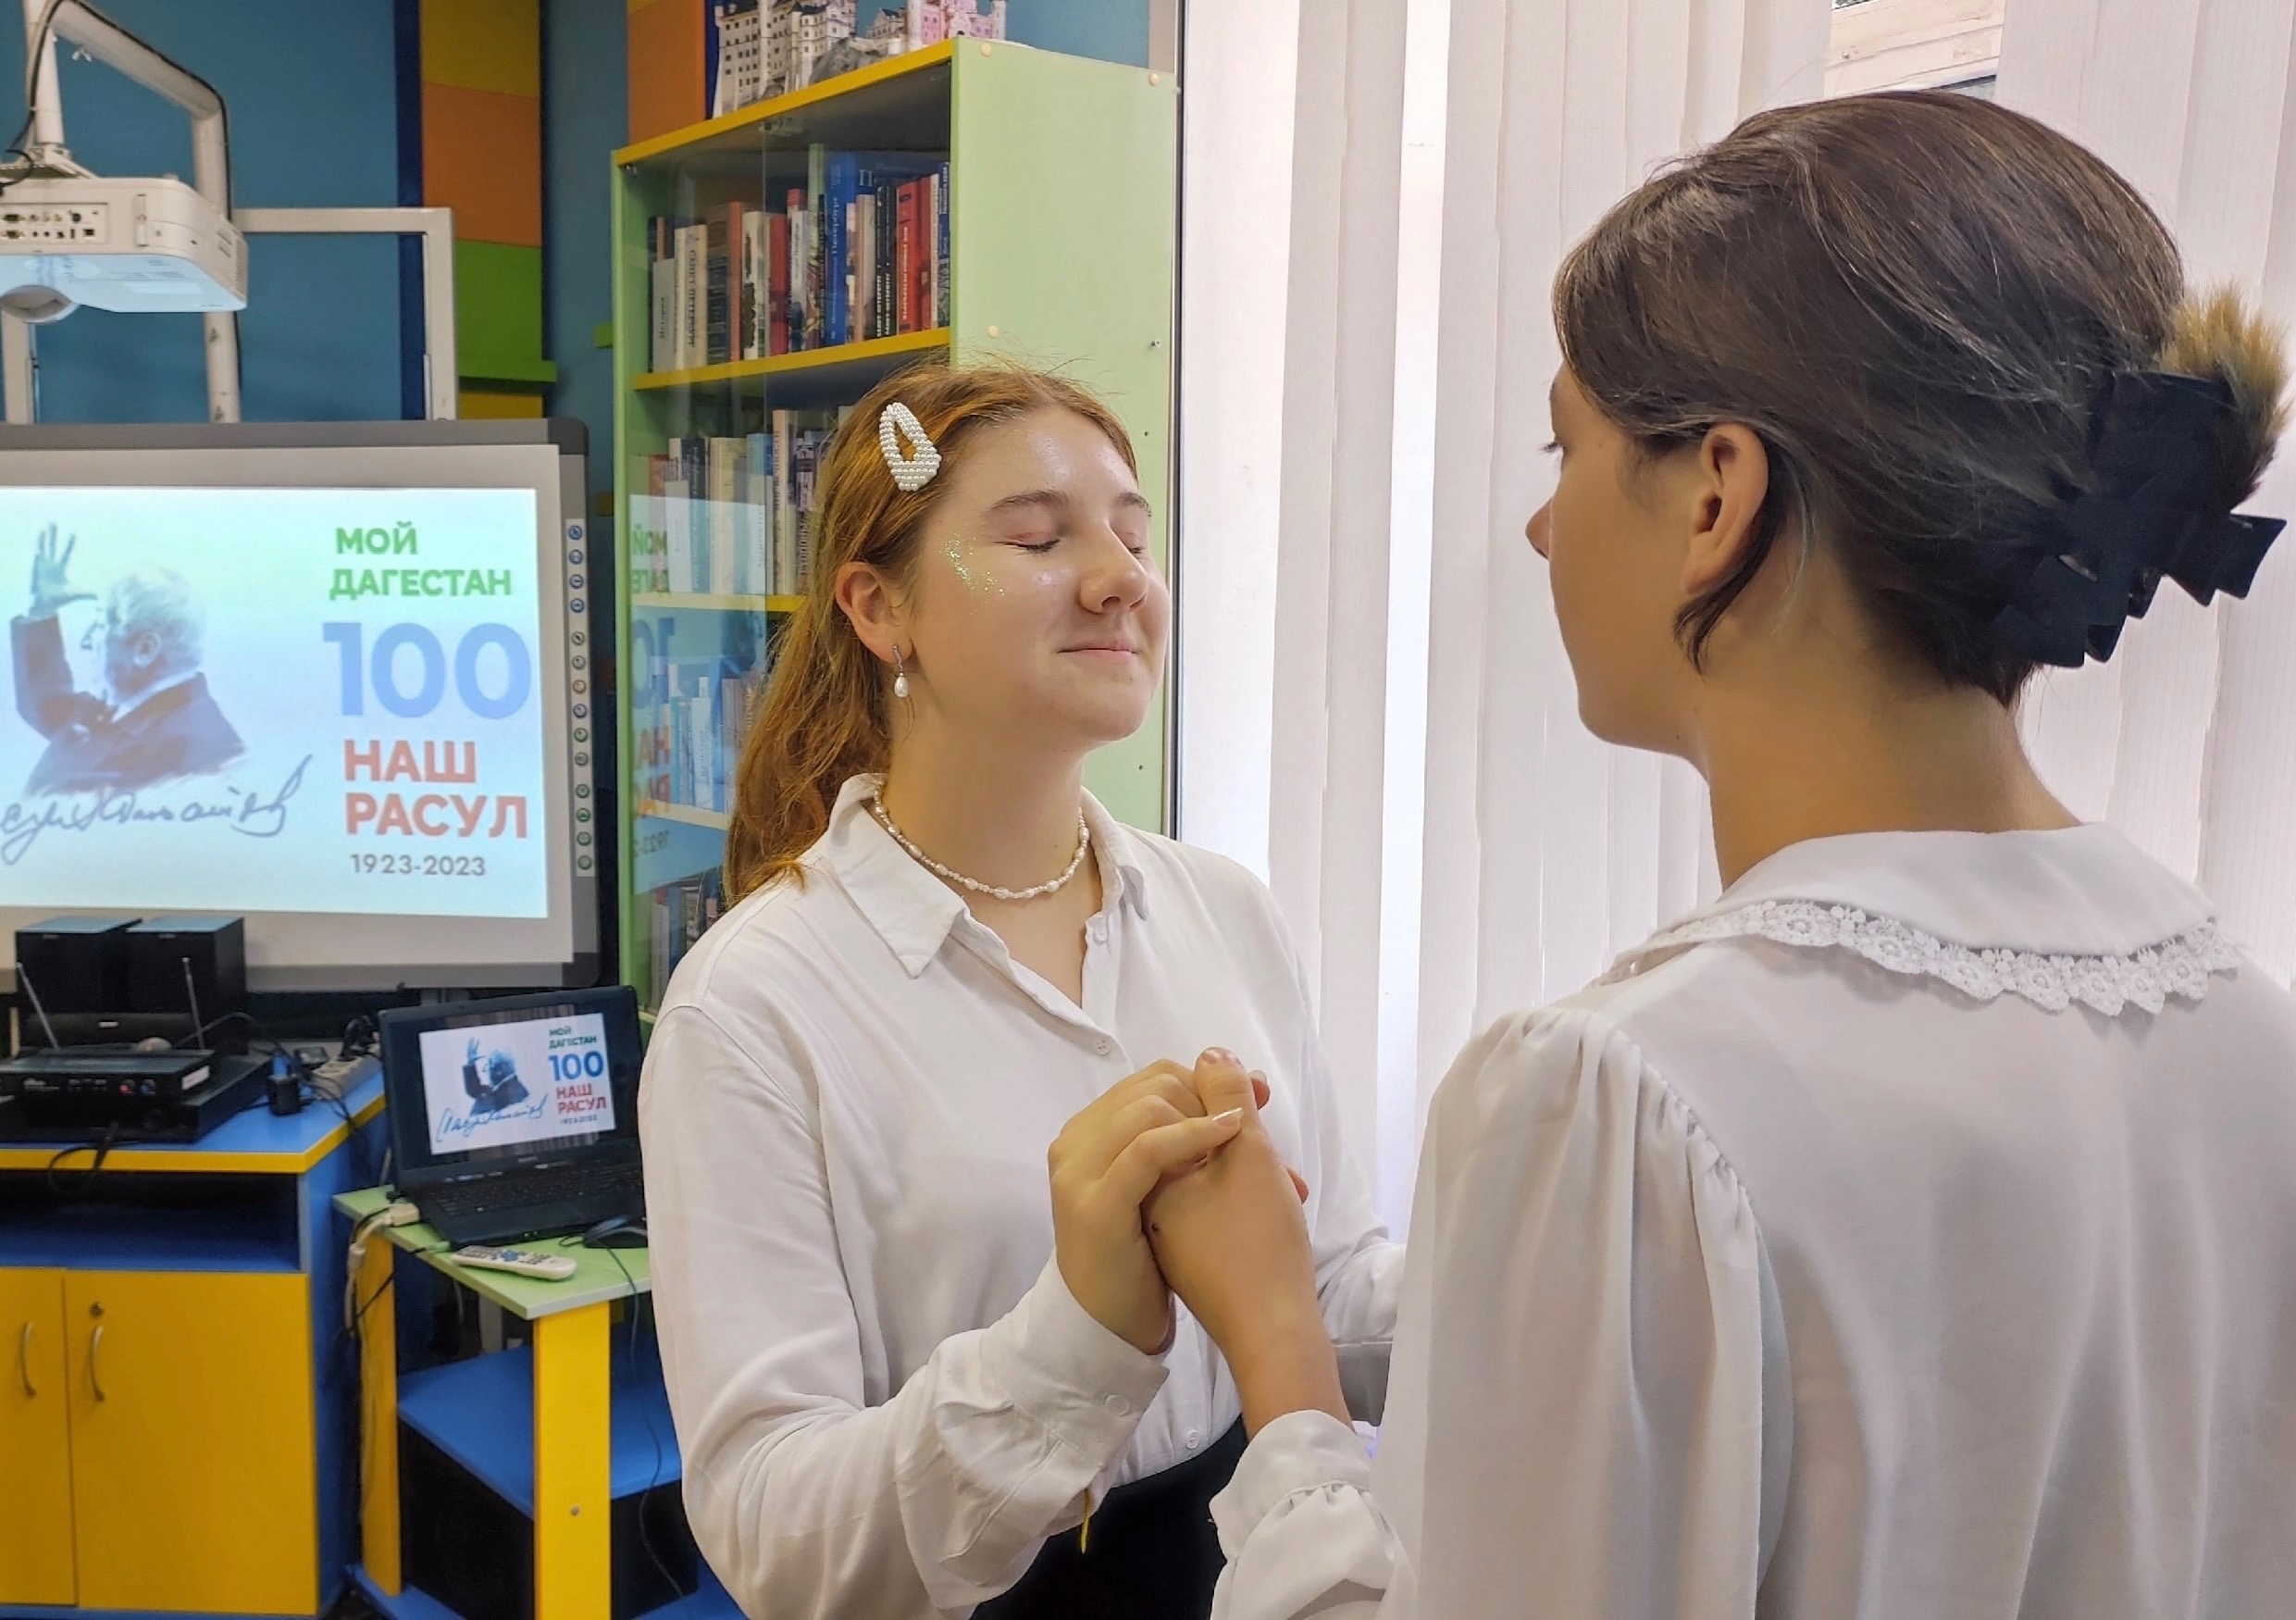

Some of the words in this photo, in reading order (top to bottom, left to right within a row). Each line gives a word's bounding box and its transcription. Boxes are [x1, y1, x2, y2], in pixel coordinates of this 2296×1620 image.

[336, 520, 417, 555] МОЙ
[329, 567, 512, 601] ДАГЕСТАН
[322, 621, 531, 720] 100
[344, 739, 477, 784] НАШ
[345, 791, 528, 839] РАСУЛ
[350, 853, 487, 877] 1923-2023
[549, 1025, 572, 1037] МОЙ
[549, 1035, 597, 1050] ДАГЕСТАН
[548, 1051, 604, 1081] 100
[556, 1083, 592, 1100] НАШ
[558, 1097, 607, 1115] РАСУЛ
